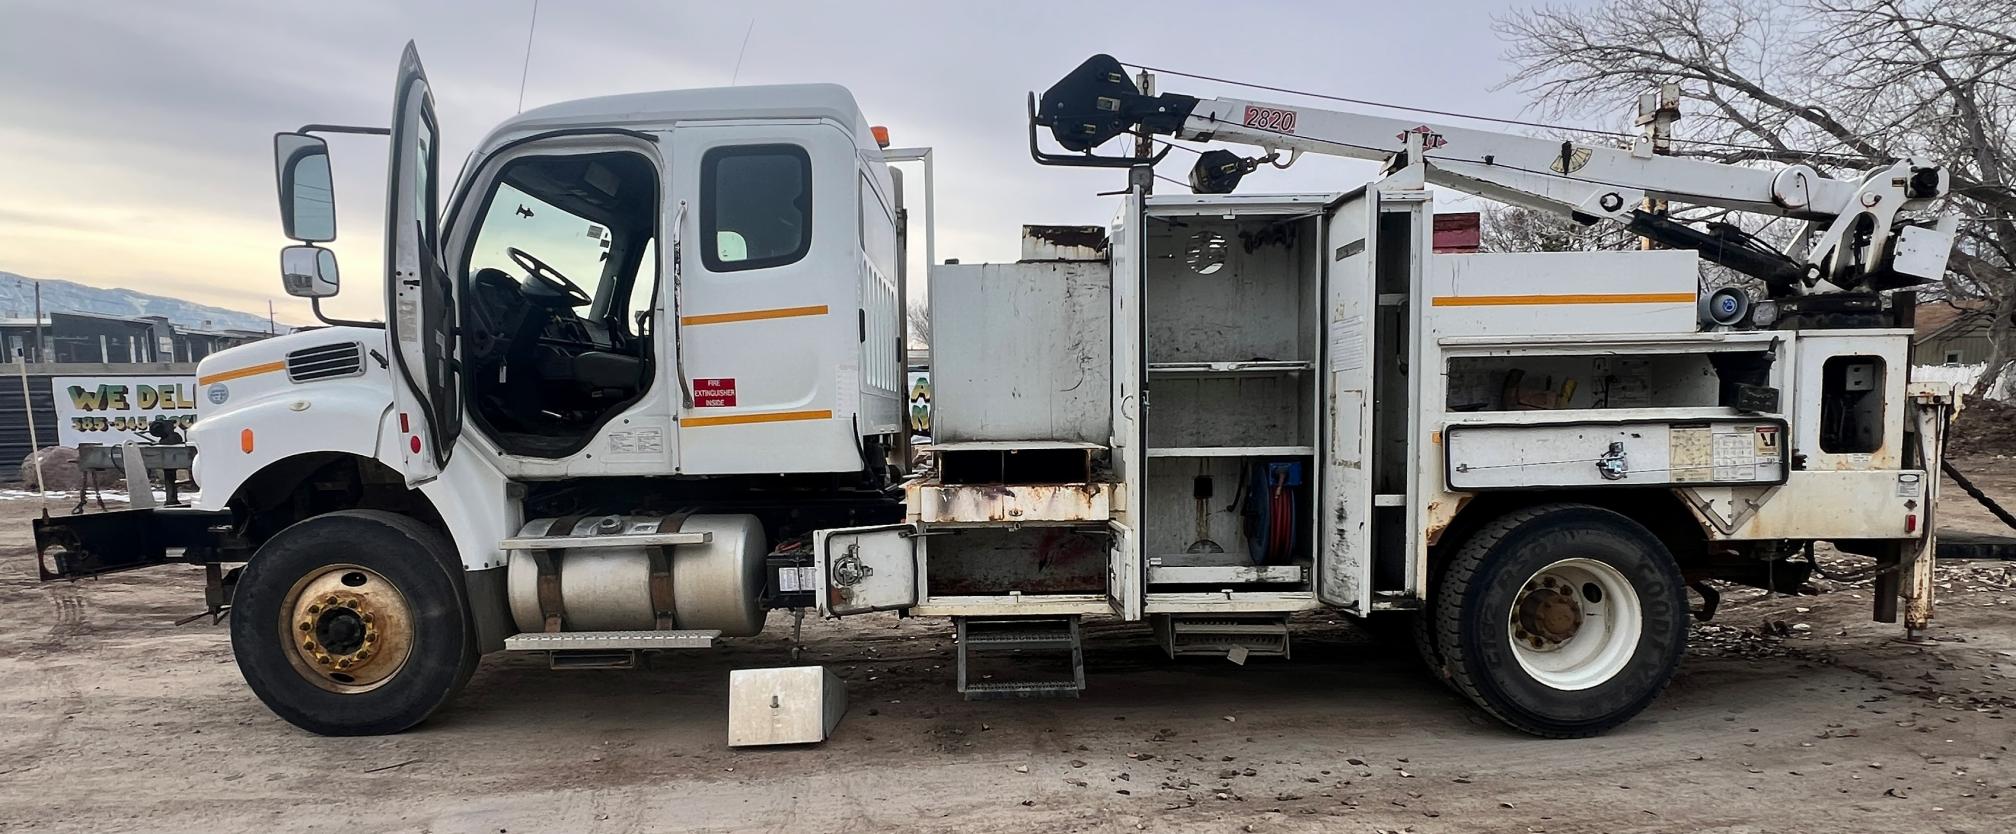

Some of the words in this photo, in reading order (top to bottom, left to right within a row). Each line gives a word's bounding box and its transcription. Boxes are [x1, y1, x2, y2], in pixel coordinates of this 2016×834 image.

[1247, 108, 1293, 131] 2820
[67, 384, 130, 411] WE
[695, 389, 735, 397] EXTINGUISHER
[706, 399, 725, 407] INSIDE
